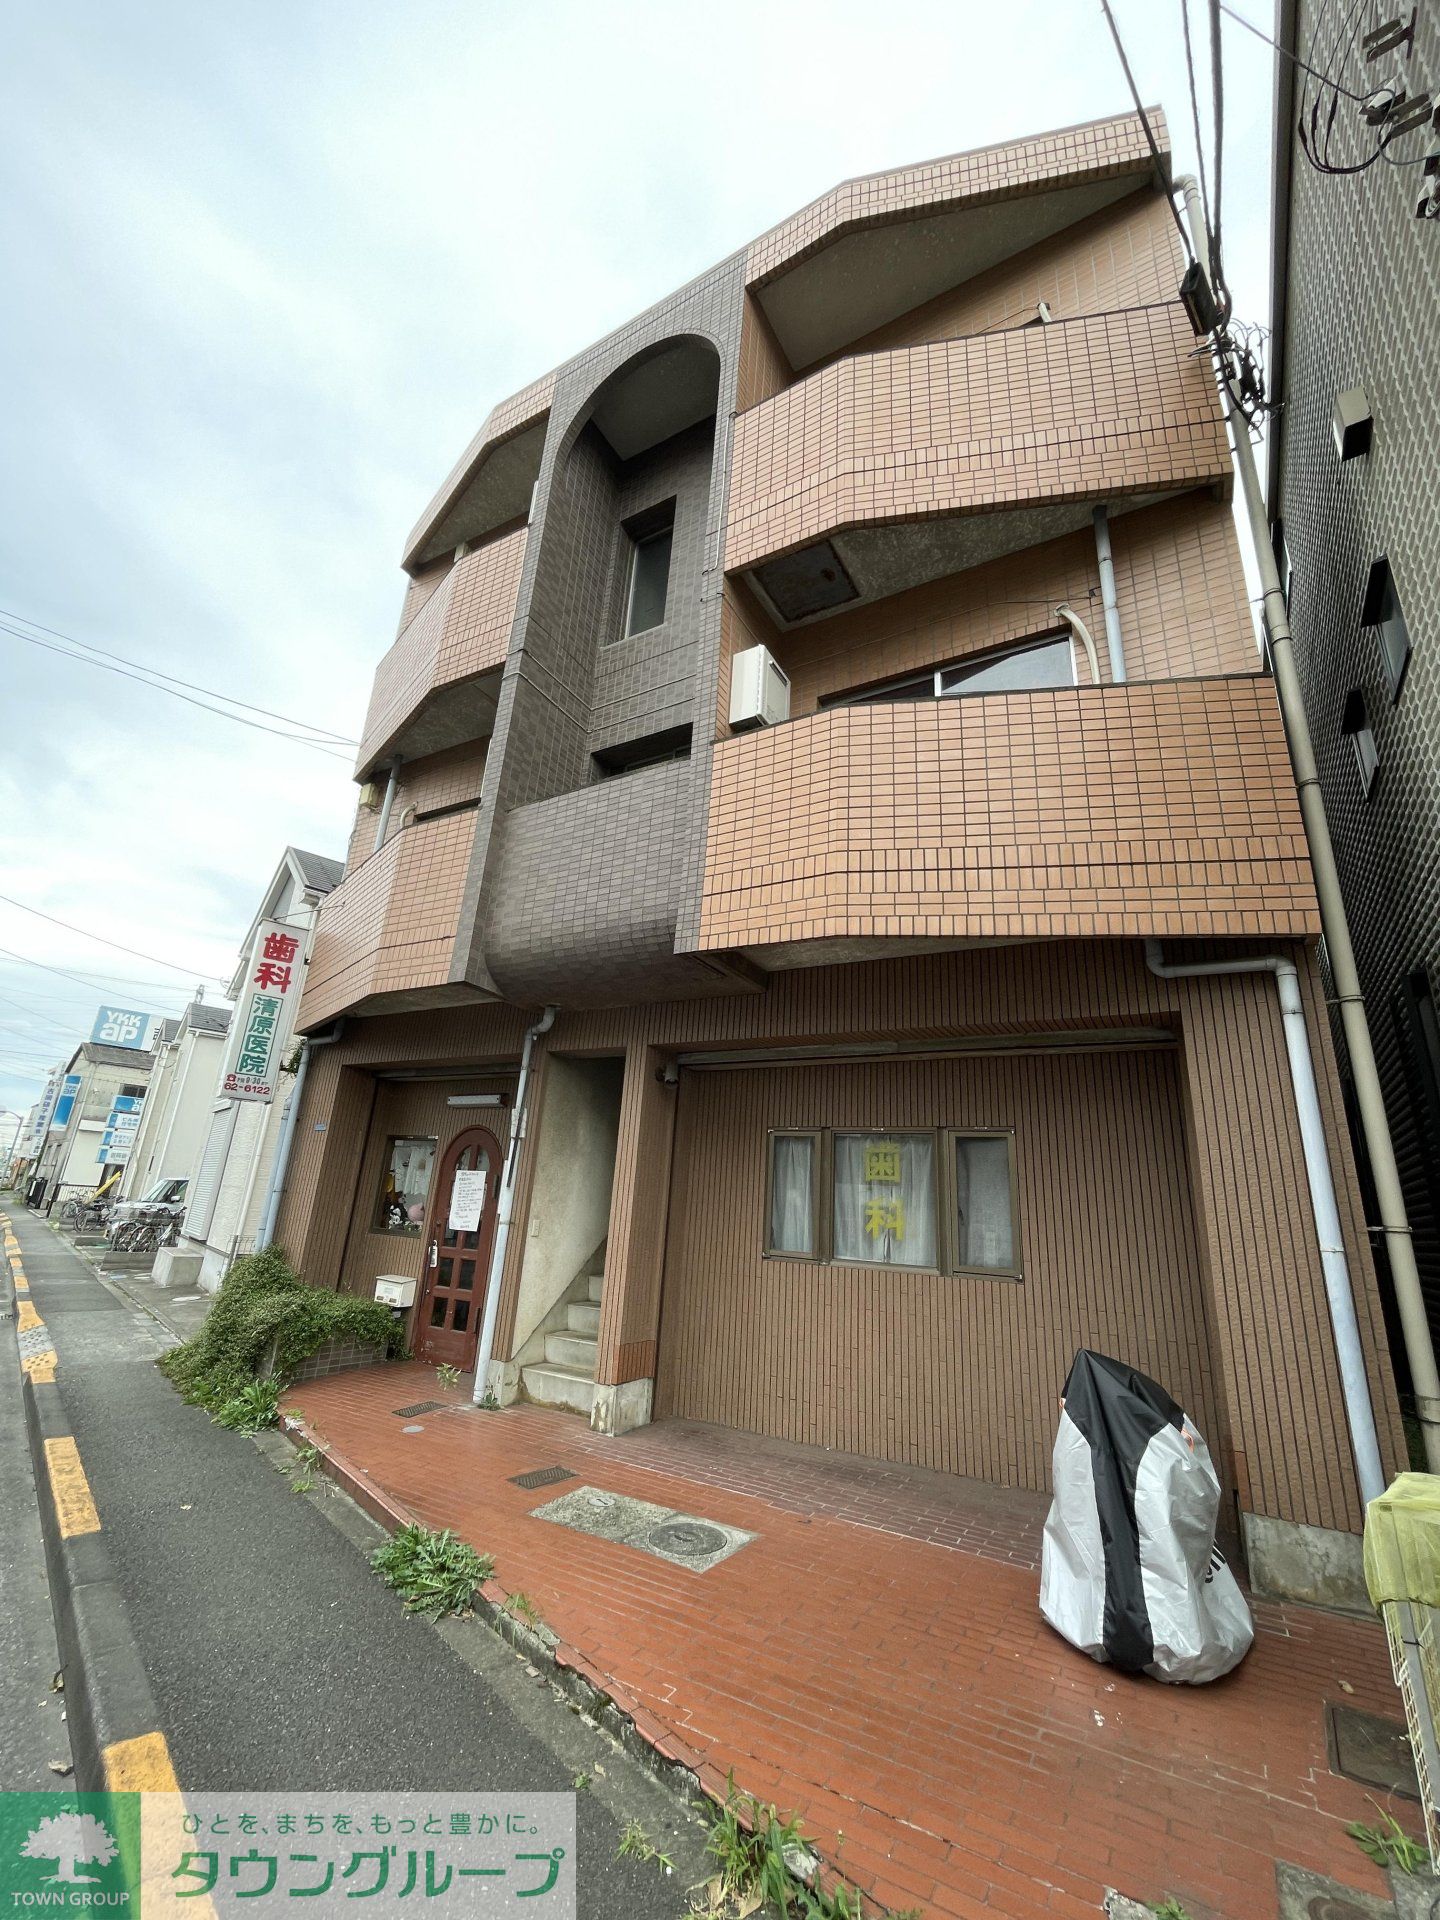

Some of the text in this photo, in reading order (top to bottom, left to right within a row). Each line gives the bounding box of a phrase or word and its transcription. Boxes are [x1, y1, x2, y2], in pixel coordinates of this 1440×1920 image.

[254, 932, 299, 994] 歯科
[107, 1011, 143, 1027] YKK
[101, 1022, 138, 1042] ap
[239, 997, 278, 1075] 清原医院
[224, 1083, 270, 1095] 62-6122
